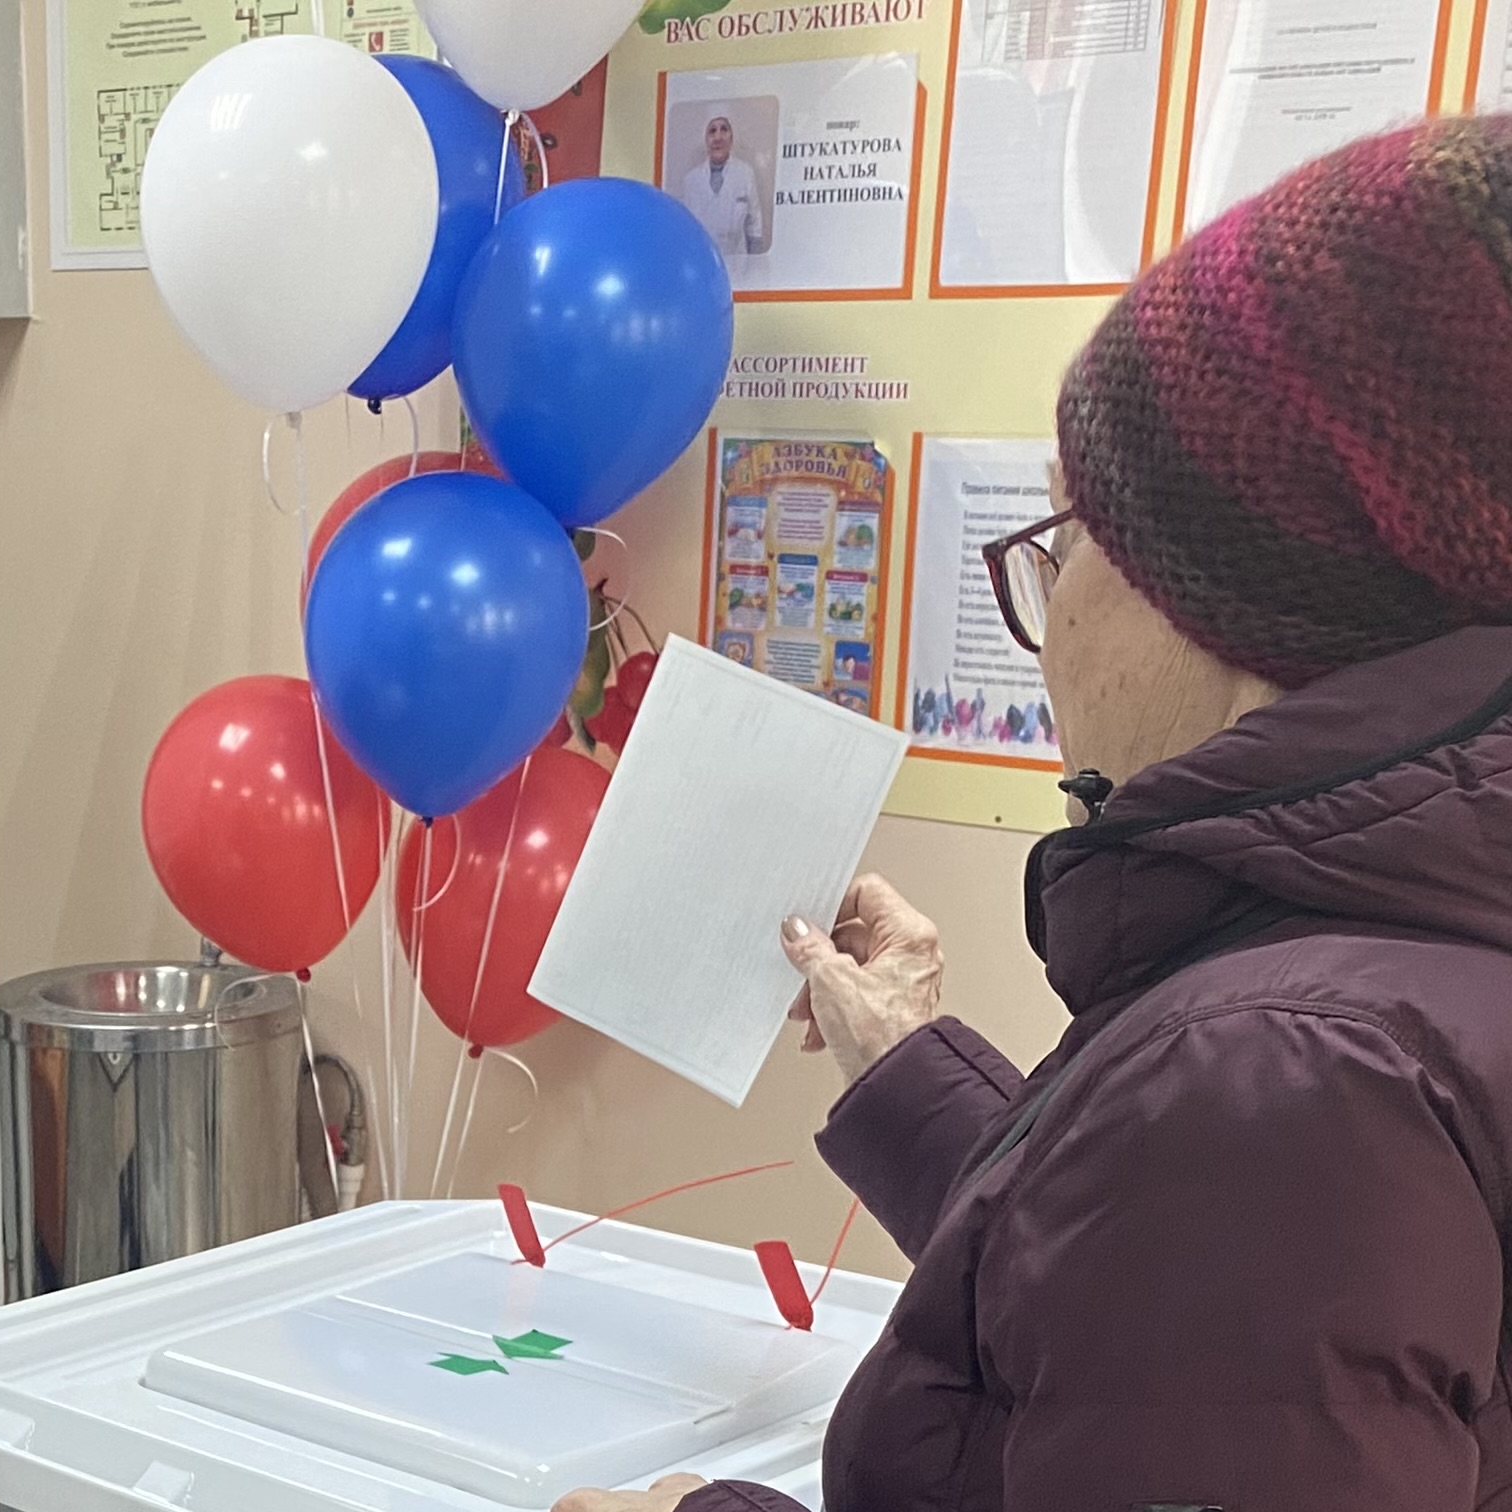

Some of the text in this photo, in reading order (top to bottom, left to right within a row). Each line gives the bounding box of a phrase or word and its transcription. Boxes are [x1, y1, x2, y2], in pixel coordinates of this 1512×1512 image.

[665, 18, 710, 44] ВАС
[782, 138, 902, 159] ШТУКАТУРОВА
[803, 162, 877, 181] НАТАЛЬЯ
[775, 186, 904, 205] ВАЛЕНТИНОВНА
[730, 356, 868, 373] АССОРТИМЕНТ
[722, 378, 908, 400] ЕТНОЙ ПРОДУКЦИИ
[772, 441, 838, 460] АЗБУКА
[761, 460, 848, 478] ЗДОРОВЬЯ
